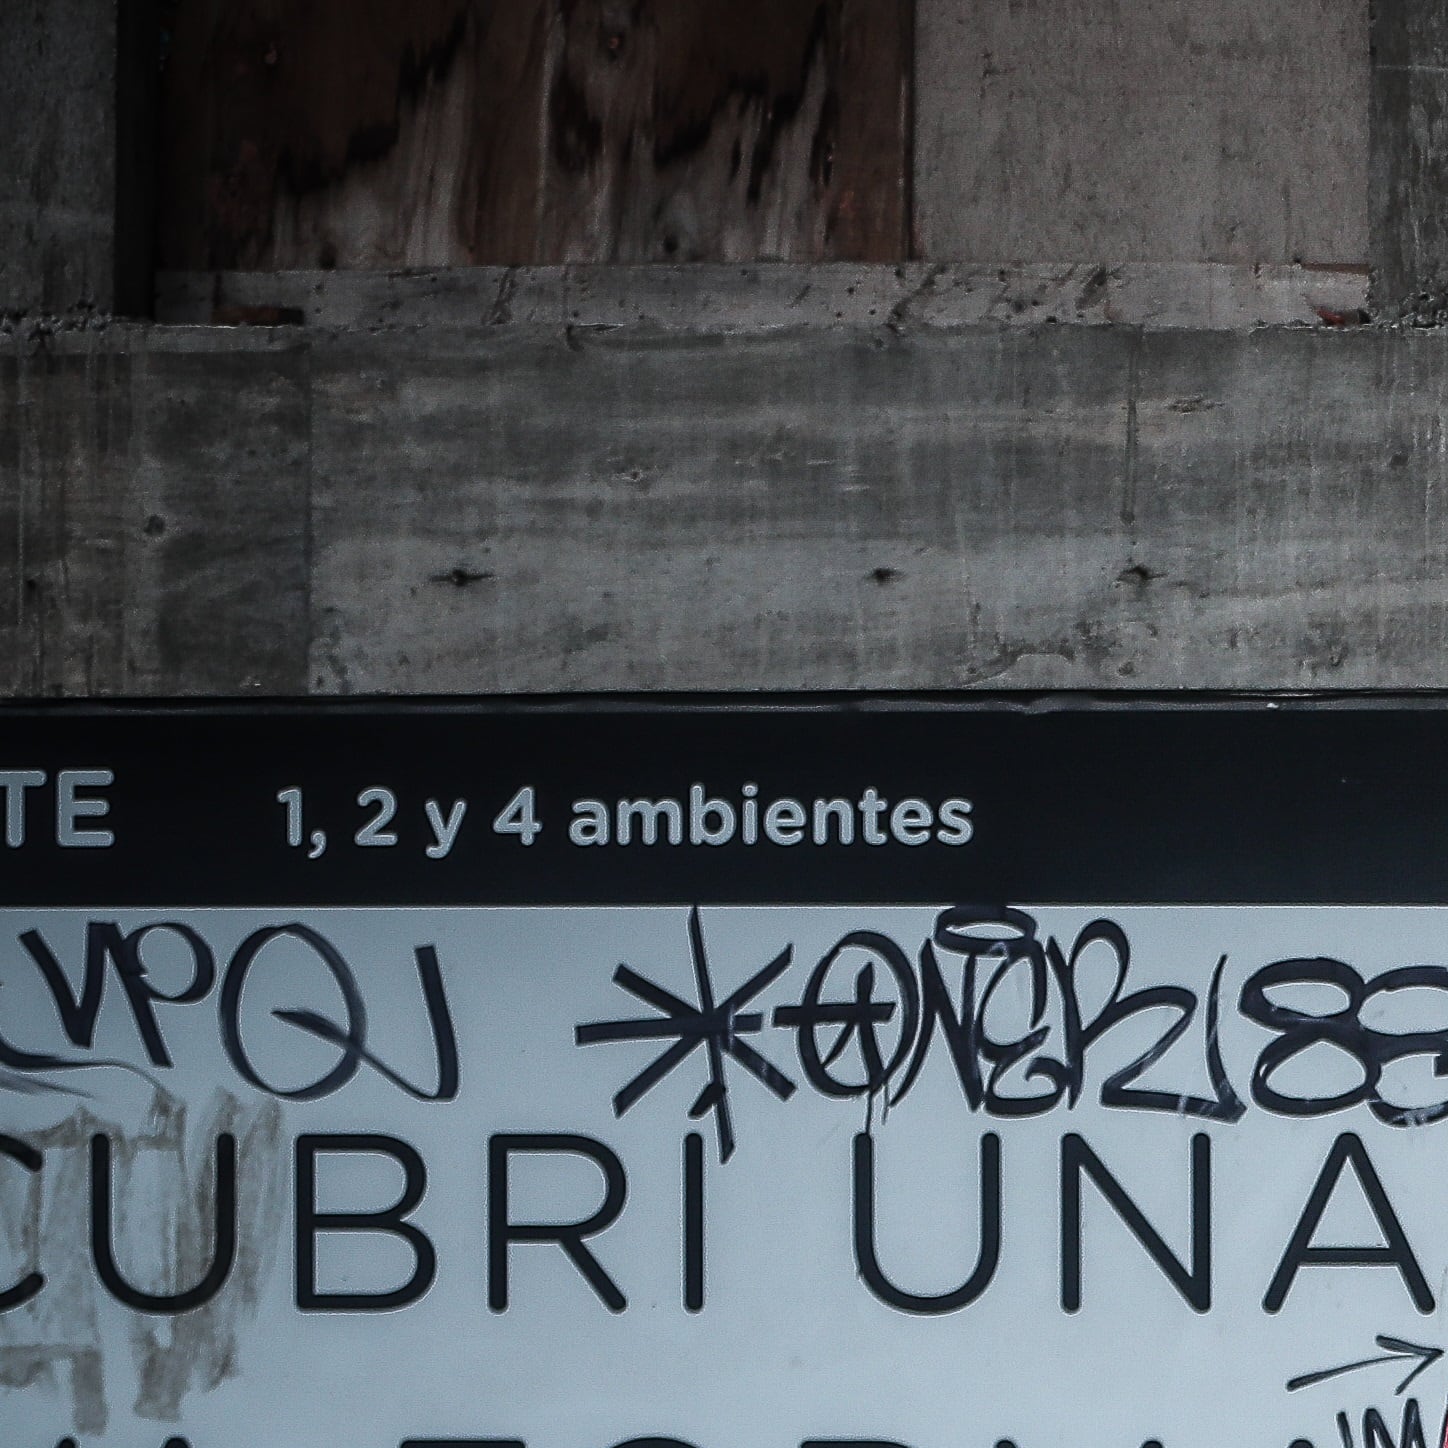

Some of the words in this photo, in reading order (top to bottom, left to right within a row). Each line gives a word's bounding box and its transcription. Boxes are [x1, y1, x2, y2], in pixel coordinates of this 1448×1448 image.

[0, 770, 114, 847] TE
[277, 787, 327, 860] 1,
[354, 787, 398, 846] 2
[425, 800, 467, 859] y
[493, 786, 542, 846] 4
[569, 784, 974, 847] ambientes
[853, 1131, 1437, 1315] UNA
